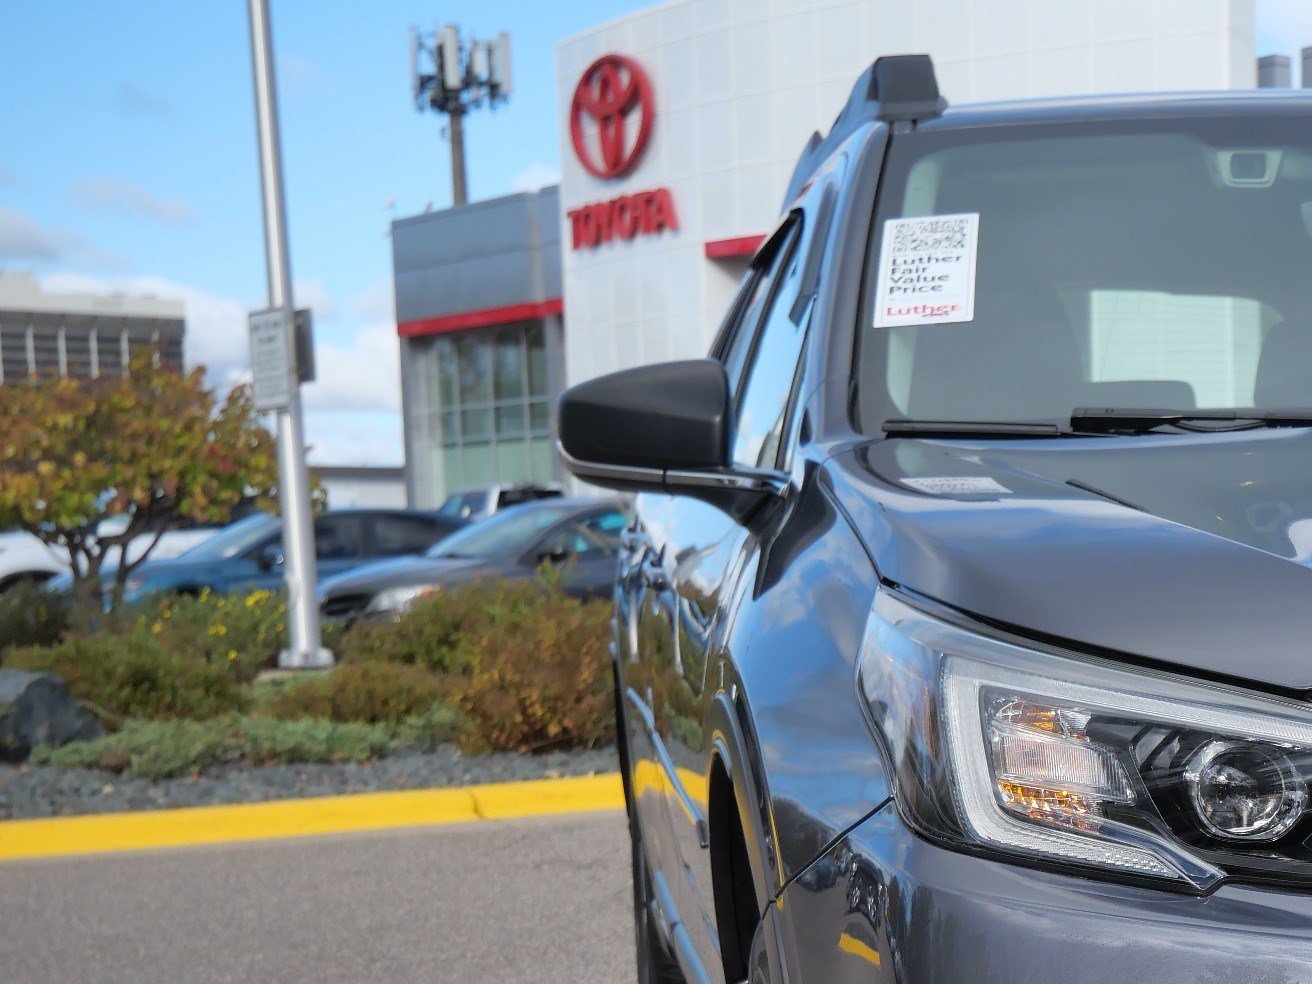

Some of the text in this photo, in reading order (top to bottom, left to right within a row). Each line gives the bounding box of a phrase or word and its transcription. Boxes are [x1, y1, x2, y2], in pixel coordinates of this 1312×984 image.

[567, 188, 678, 250] TOYOTA
[892, 255, 962, 266] Luther
[891, 266, 928, 275] Fair
[890, 274, 950, 284] Value
[889, 284, 943, 295] Price
[886, 304, 960, 317] Luther
